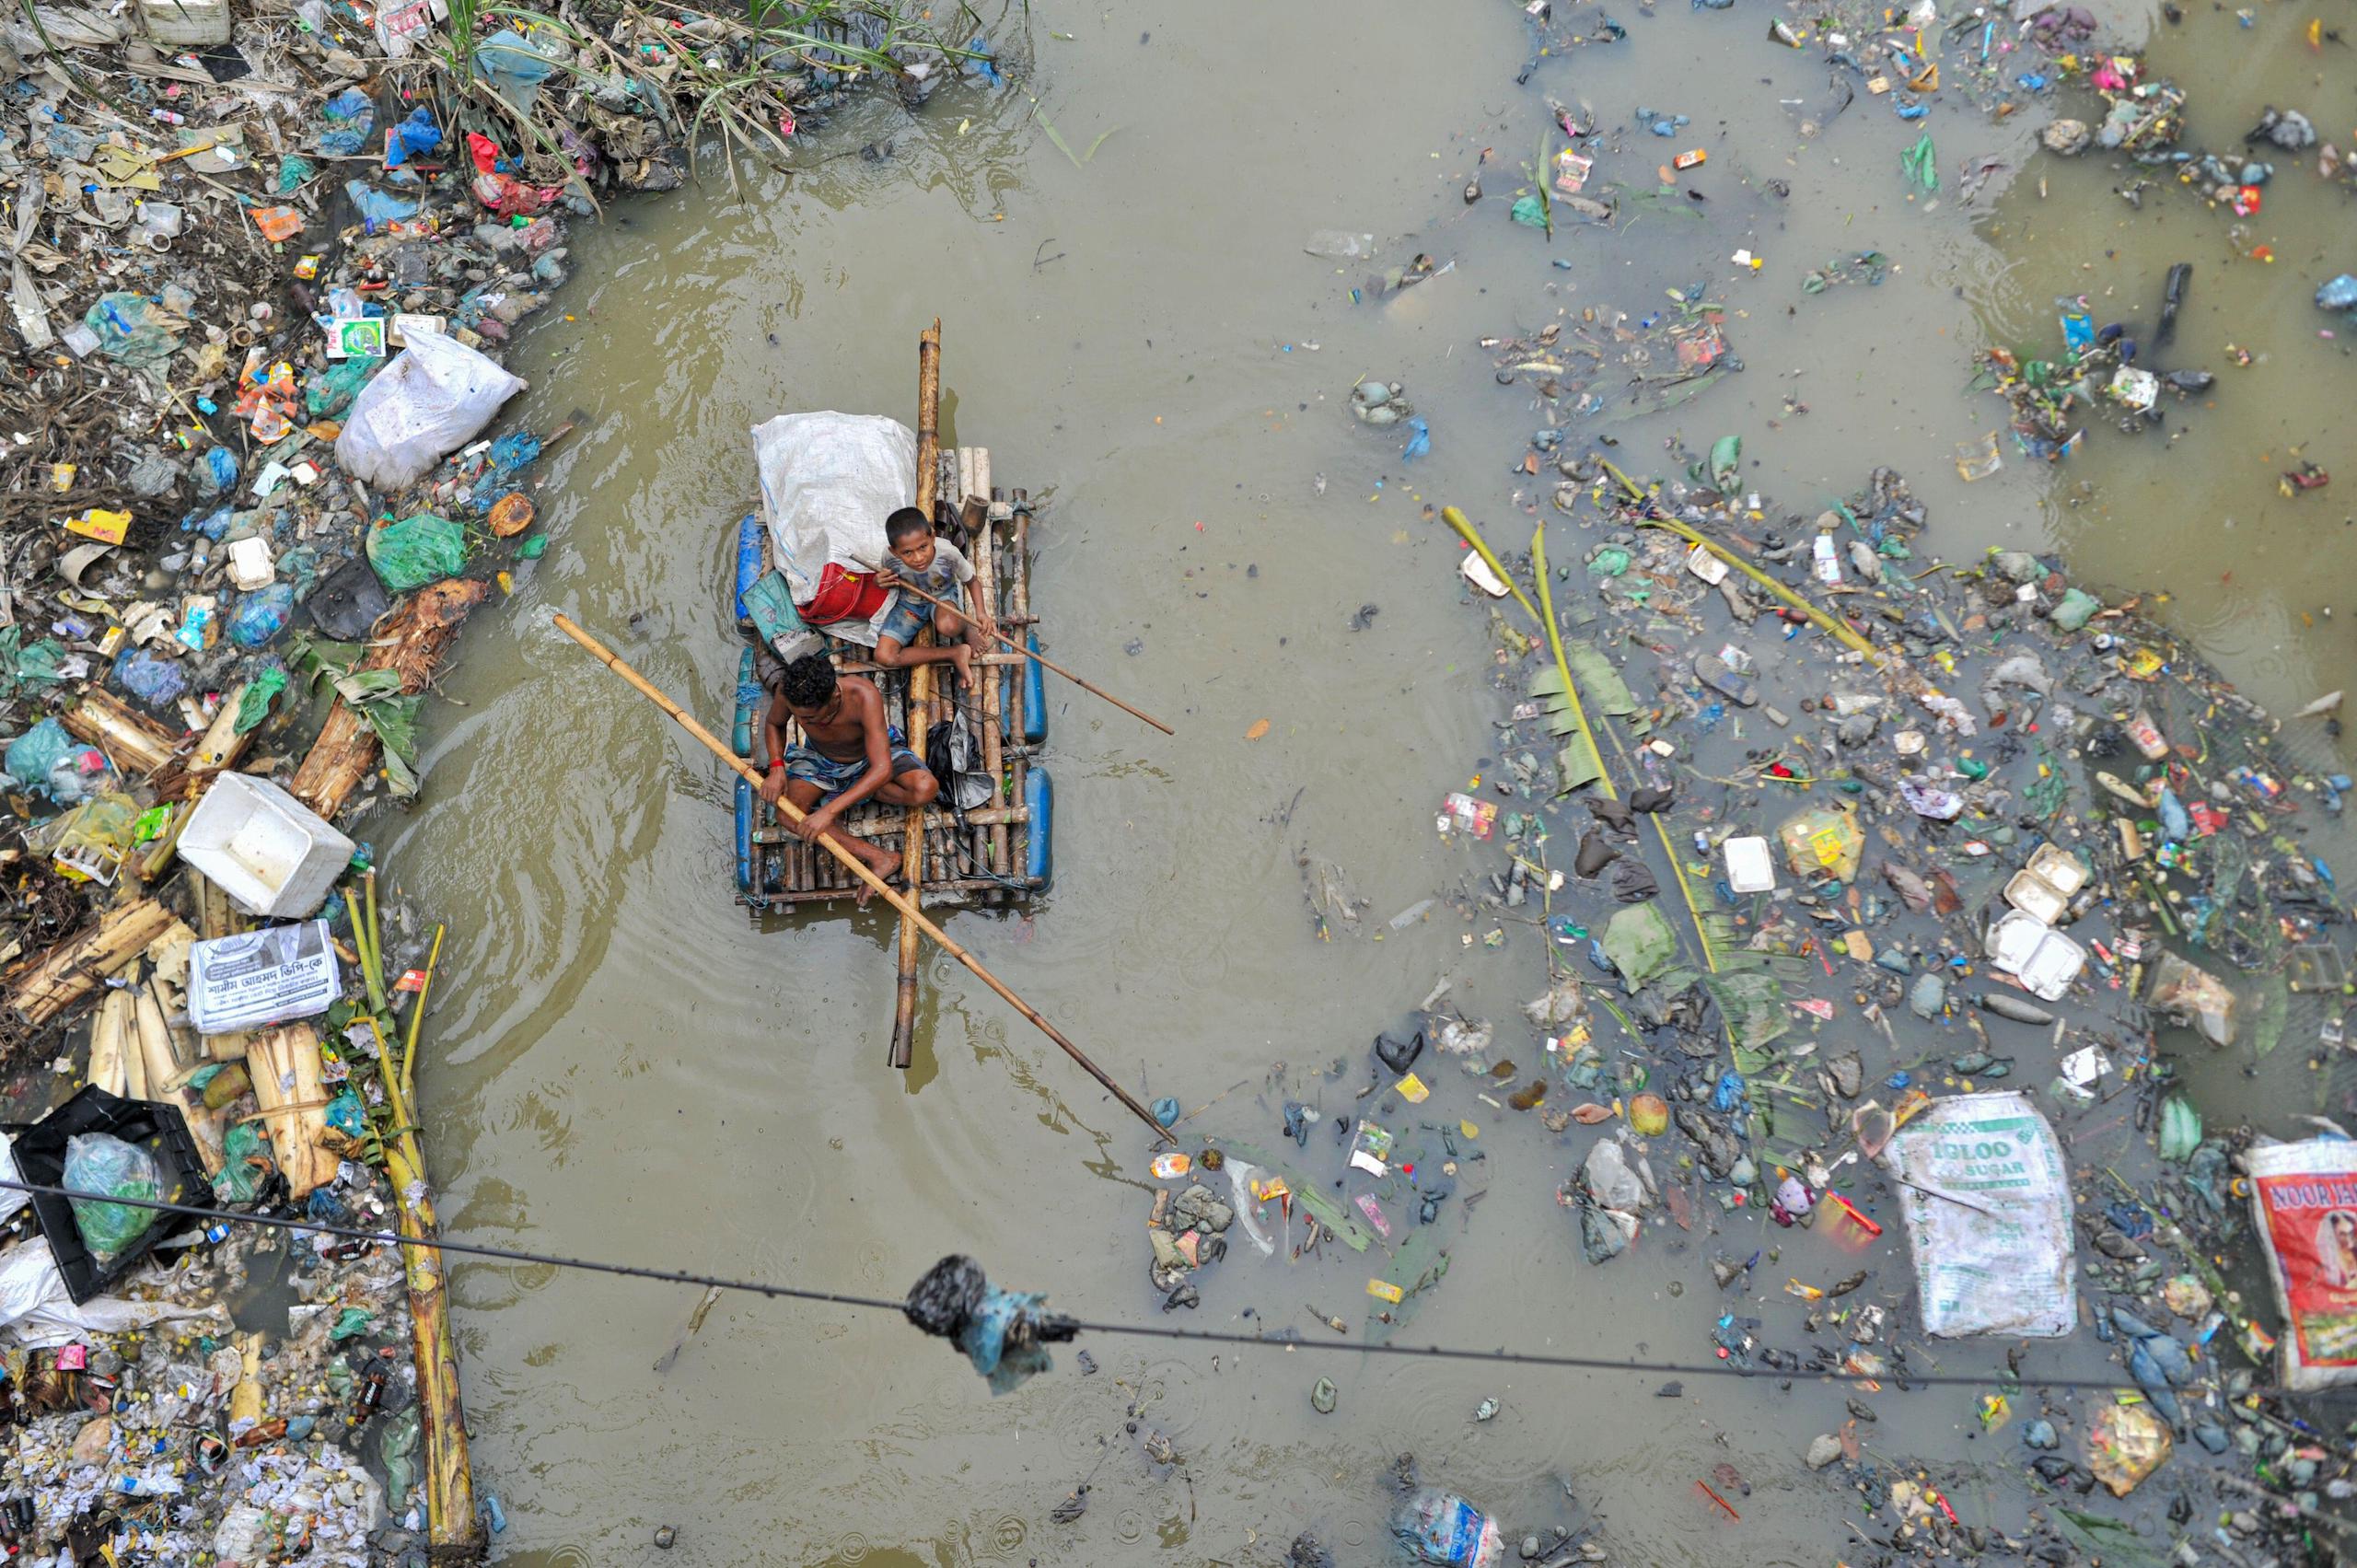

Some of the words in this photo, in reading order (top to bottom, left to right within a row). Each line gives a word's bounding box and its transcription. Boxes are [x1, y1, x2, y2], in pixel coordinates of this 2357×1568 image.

[207, 980, 238, 993] শামীম
[280, 958, 322, 978] ভিপি-কে
[1933, 1141, 2012, 1160] IGLOO
[1965, 1161, 2026, 1177] SUGAR
[2270, 1183, 2331, 1209] NOOR
